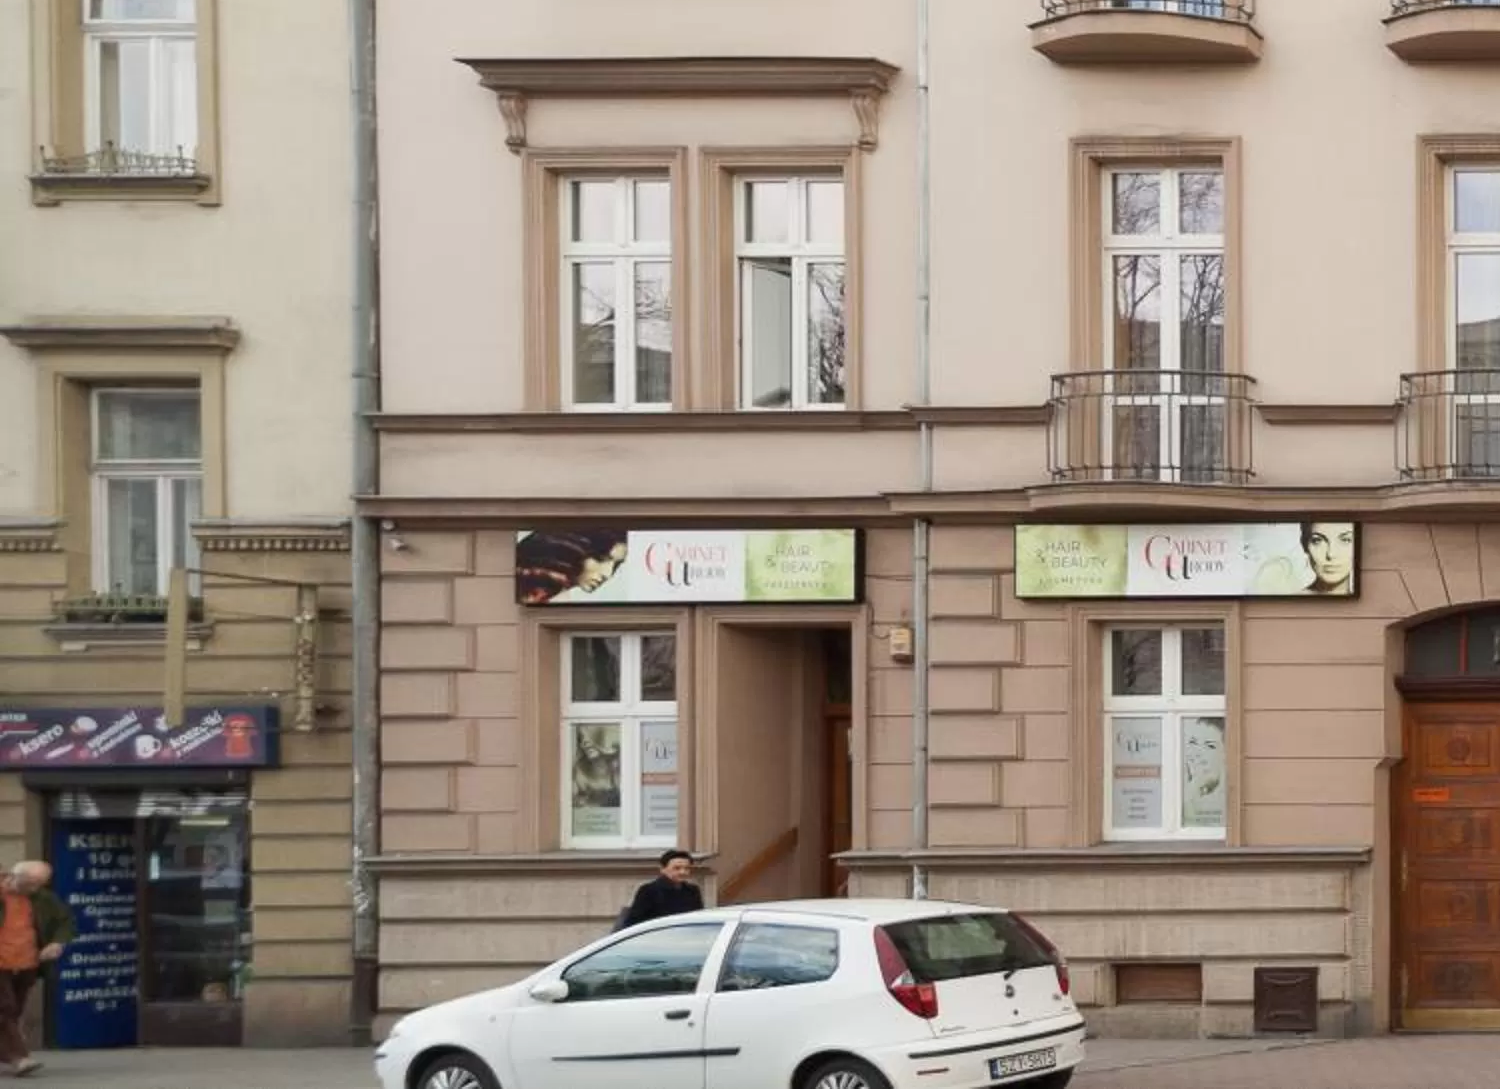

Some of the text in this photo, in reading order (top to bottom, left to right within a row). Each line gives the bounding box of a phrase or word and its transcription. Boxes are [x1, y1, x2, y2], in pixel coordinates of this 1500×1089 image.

[775, 544, 811, 556] HAIR
[1045, 541, 1082, 554] HAIR
[1051, 556, 1108, 570] BEAUTY
